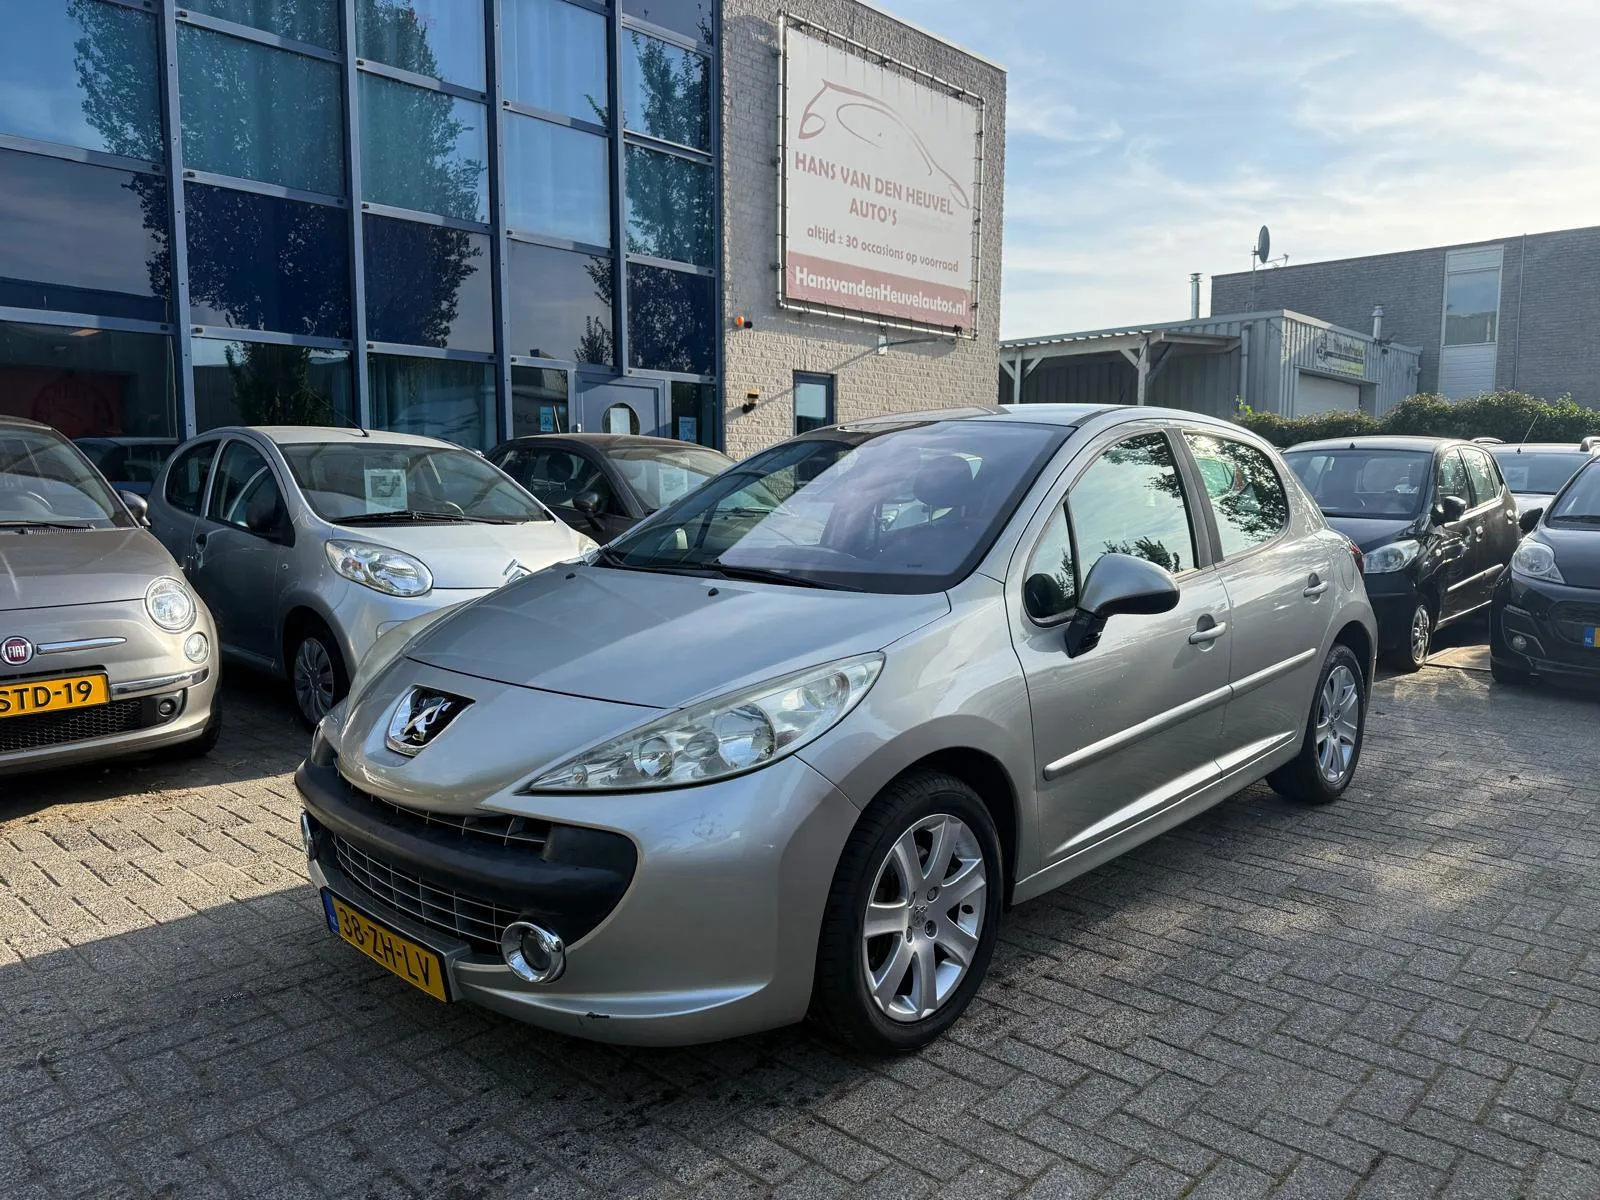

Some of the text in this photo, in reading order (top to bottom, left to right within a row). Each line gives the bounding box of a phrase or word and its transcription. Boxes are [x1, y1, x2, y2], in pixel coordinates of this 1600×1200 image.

[795, 151, 954, 215] HANS VAN DEN HEUVEL
[849, 197, 897, 226] AUTO'S
[807, 225, 836, 245] altijd
[845, 234, 859, 249] 30
[861, 240, 904, 261] occasions
[905, 251, 918, 265] op
[920, 255, 959, 273] voorraad
[795, 265, 967, 316] HansvandenHeuvelautos.nl
[7, 645, 26, 659] FIAT
[338, 906, 430, 987] 38-ZH-LV
